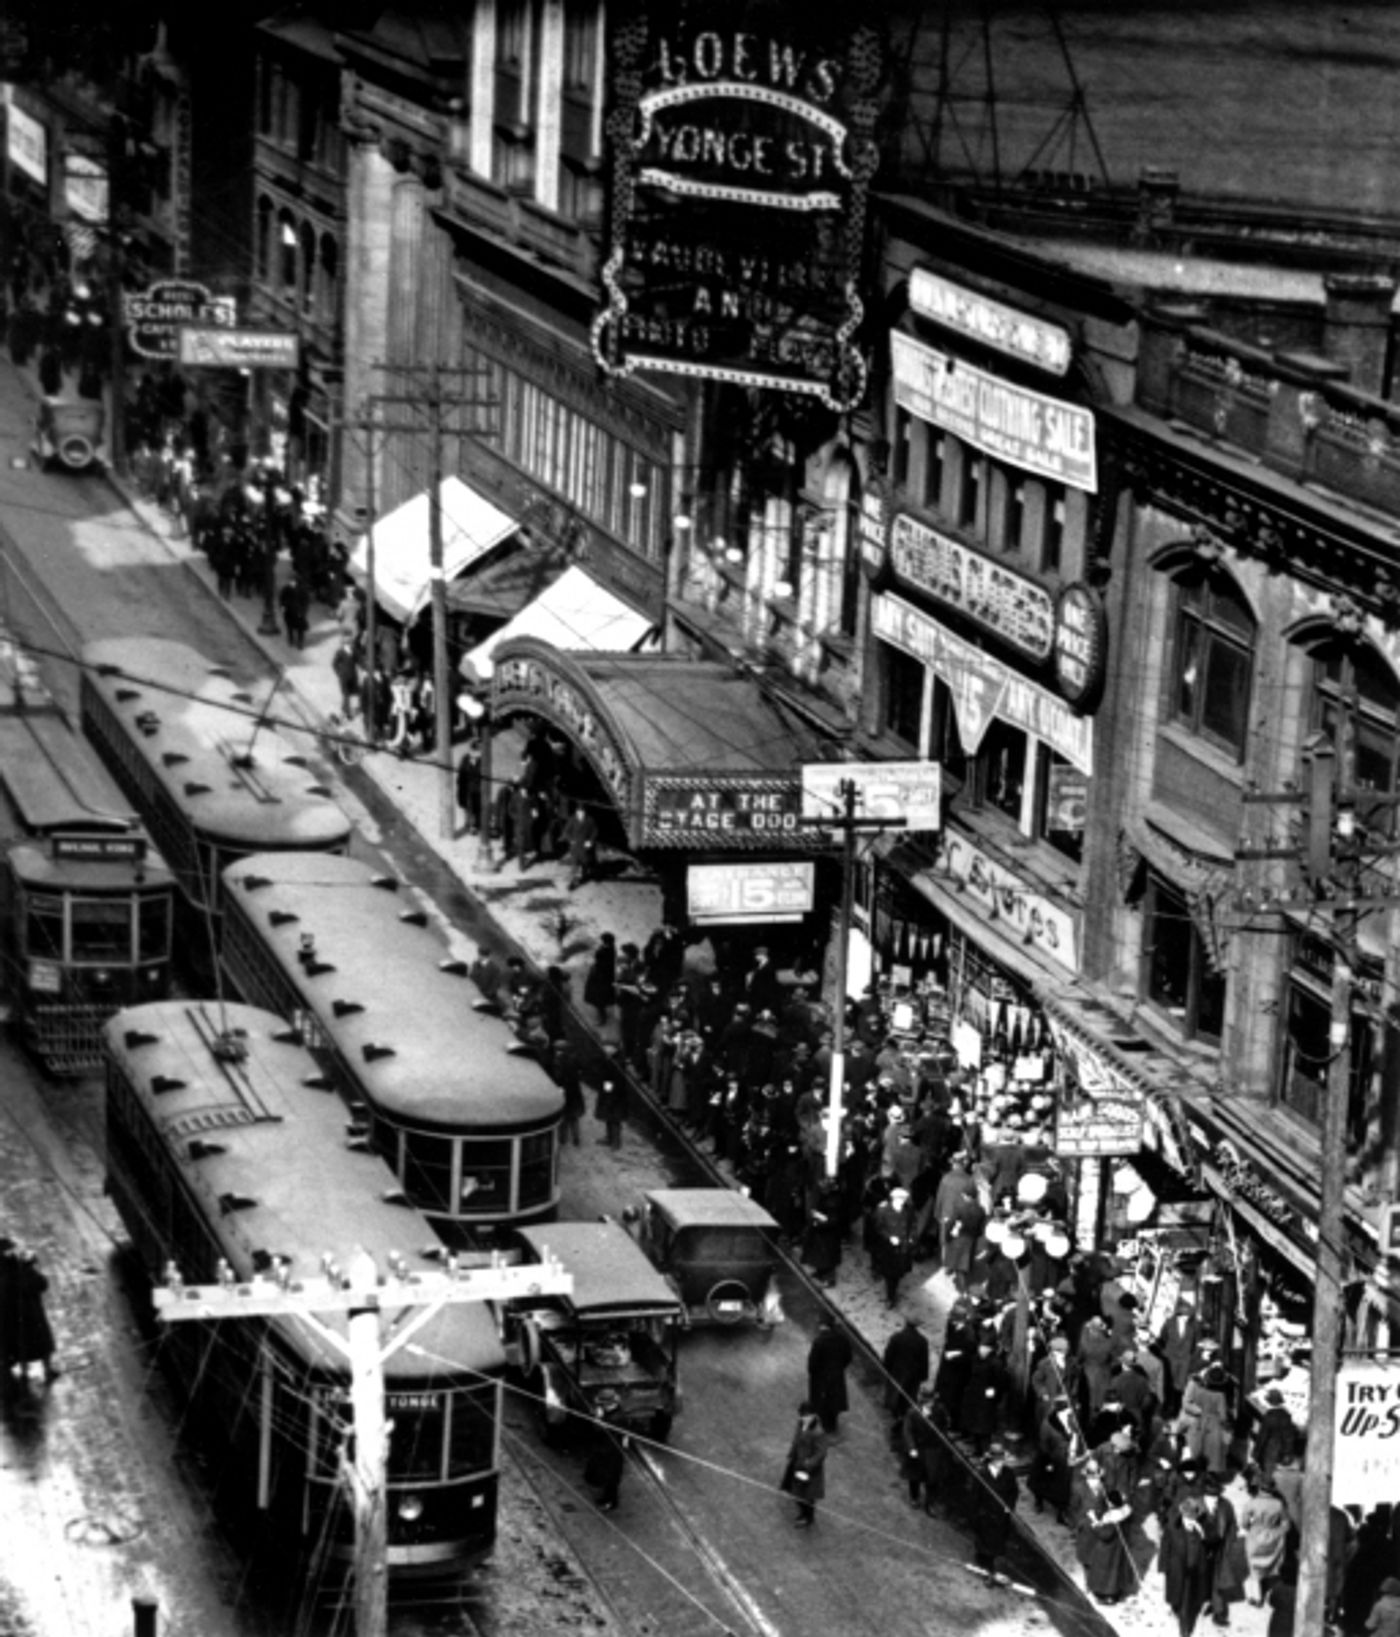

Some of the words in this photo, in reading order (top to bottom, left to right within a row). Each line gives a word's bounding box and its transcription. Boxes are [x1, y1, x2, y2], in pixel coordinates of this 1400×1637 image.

[655, 121, 774, 174] YONGE
[786, 142, 825, 178] ST
[691, 793, 721, 809] AT
[739, 793, 782, 811] THE
[658, 810, 735, 829] STAGE
[752, 813, 796, 829] DOO
[731, 879, 774, 908] 15
[1346, 1382, 1392, 1403] TRY
